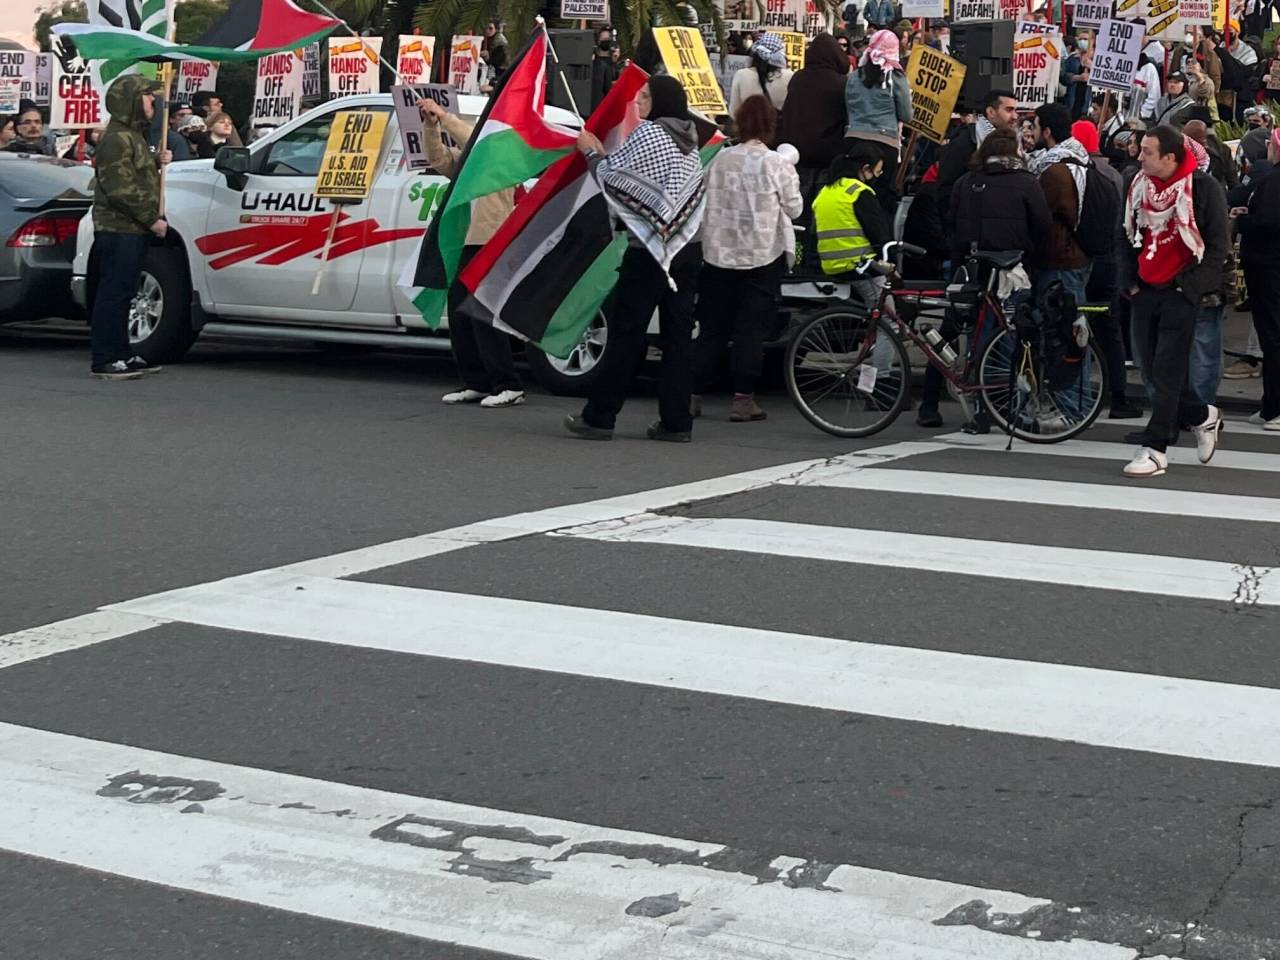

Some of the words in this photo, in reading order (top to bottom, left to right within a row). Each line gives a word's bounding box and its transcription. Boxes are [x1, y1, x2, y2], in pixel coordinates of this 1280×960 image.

[564, 3, 604, 13] PALESTINE
[767, 0, 785, 12] OFF
[961, 3, 991, 18] RAFAH!
[1076, 4, 1109, 20] RAFAH
[1180, 2, 1209, 10] BOMBING
[766, 13, 795, 28] AFAH!
[1003, 9, 1019, 20] OFF
[1180, 10, 1210, 19] HOSPITALS
[1021, 22, 1054, 34] FREE
[1109, 23, 1133, 40] END
[668, 29, 693, 49] END
[1107, 38, 1127, 55] ALL
[1, 53, 24, 64] END
[259, 53, 293, 76] HANDS
[331, 57, 367, 73] HANDS
[399, 57, 424, 75] HANDS
[452, 56, 472, 73] HANDS
[678, 49, 701, 69] ALL
[919, 51, 954, 78] BIDEN:
[1095, 55, 1113, 70] U.S.
[1115, 59, 1133, 74] AID
[1, 66, 23, 77] ALL
[181, 61, 211, 77] HANDS
[1092, 69, 1101, 79] TO
[1102, 70, 1132, 84] ISRAEL!
[185, 77, 203, 91] OFF
[264, 75, 283, 96] OFF
[338, 75, 359, 89] OFF
[454, 74, 466, 89] OFF
[915, 69, 947, 95] STOP
[1017, 70, 1037, 86] OFF
[911, 90, 940, 115] RMING
[1014, 87, 1044, 103] AFAH!
[64, 100, 101, 124] FIRE
[255, 97, 291, 118] RAFAH!
[344, 113, 372, 133] END
[912, 105, 935, 128] RAEL
[340, 133, 364, 153] ALL
[328, 156, 347, 170] U.S.
[351, 156, 368, 170] AID
[320, 172, 333, 185] TO
[334, 172, 367, 187] ISRAEL
